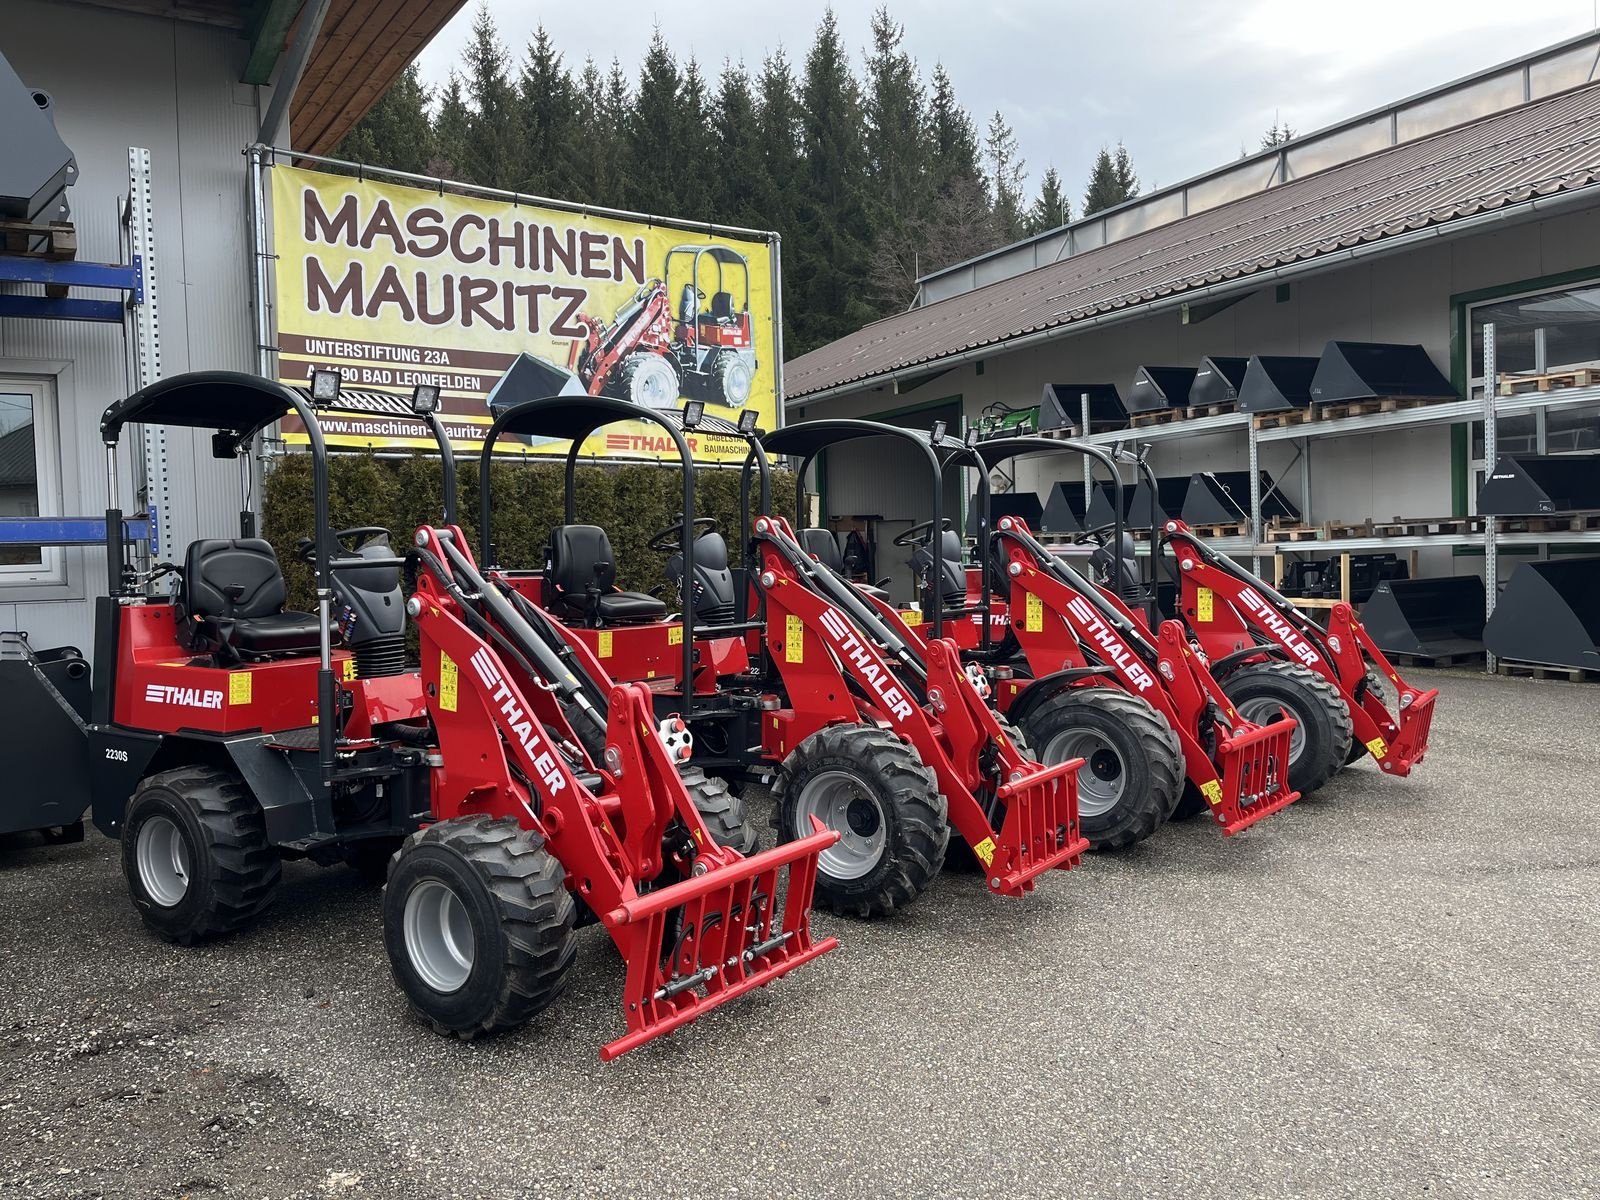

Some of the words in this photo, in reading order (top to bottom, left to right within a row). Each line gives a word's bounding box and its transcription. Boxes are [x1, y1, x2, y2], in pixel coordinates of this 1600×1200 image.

[304, 189, 644, 284] MASCHINEN
[306, 256, 588, 338] MAURITZ
[305, 339, 420, 363] UNTERSTIFTUNG
[424, 350, 450, 365] 23A
[362, 369, 392, 384] BAD
[396, 371, 480, 390] LEONFELDEN
[630, 435, 698, 453] THALR
[1087, 616, 1153, 692] THALER
[1257, 604, 1319, 667] THALER
[164, 686, 224, 709] THALER
[841, 632, 913, 722] THALER
[105, 748, 128, 762] 2230S
[492, 679, 566, 797] THALER
